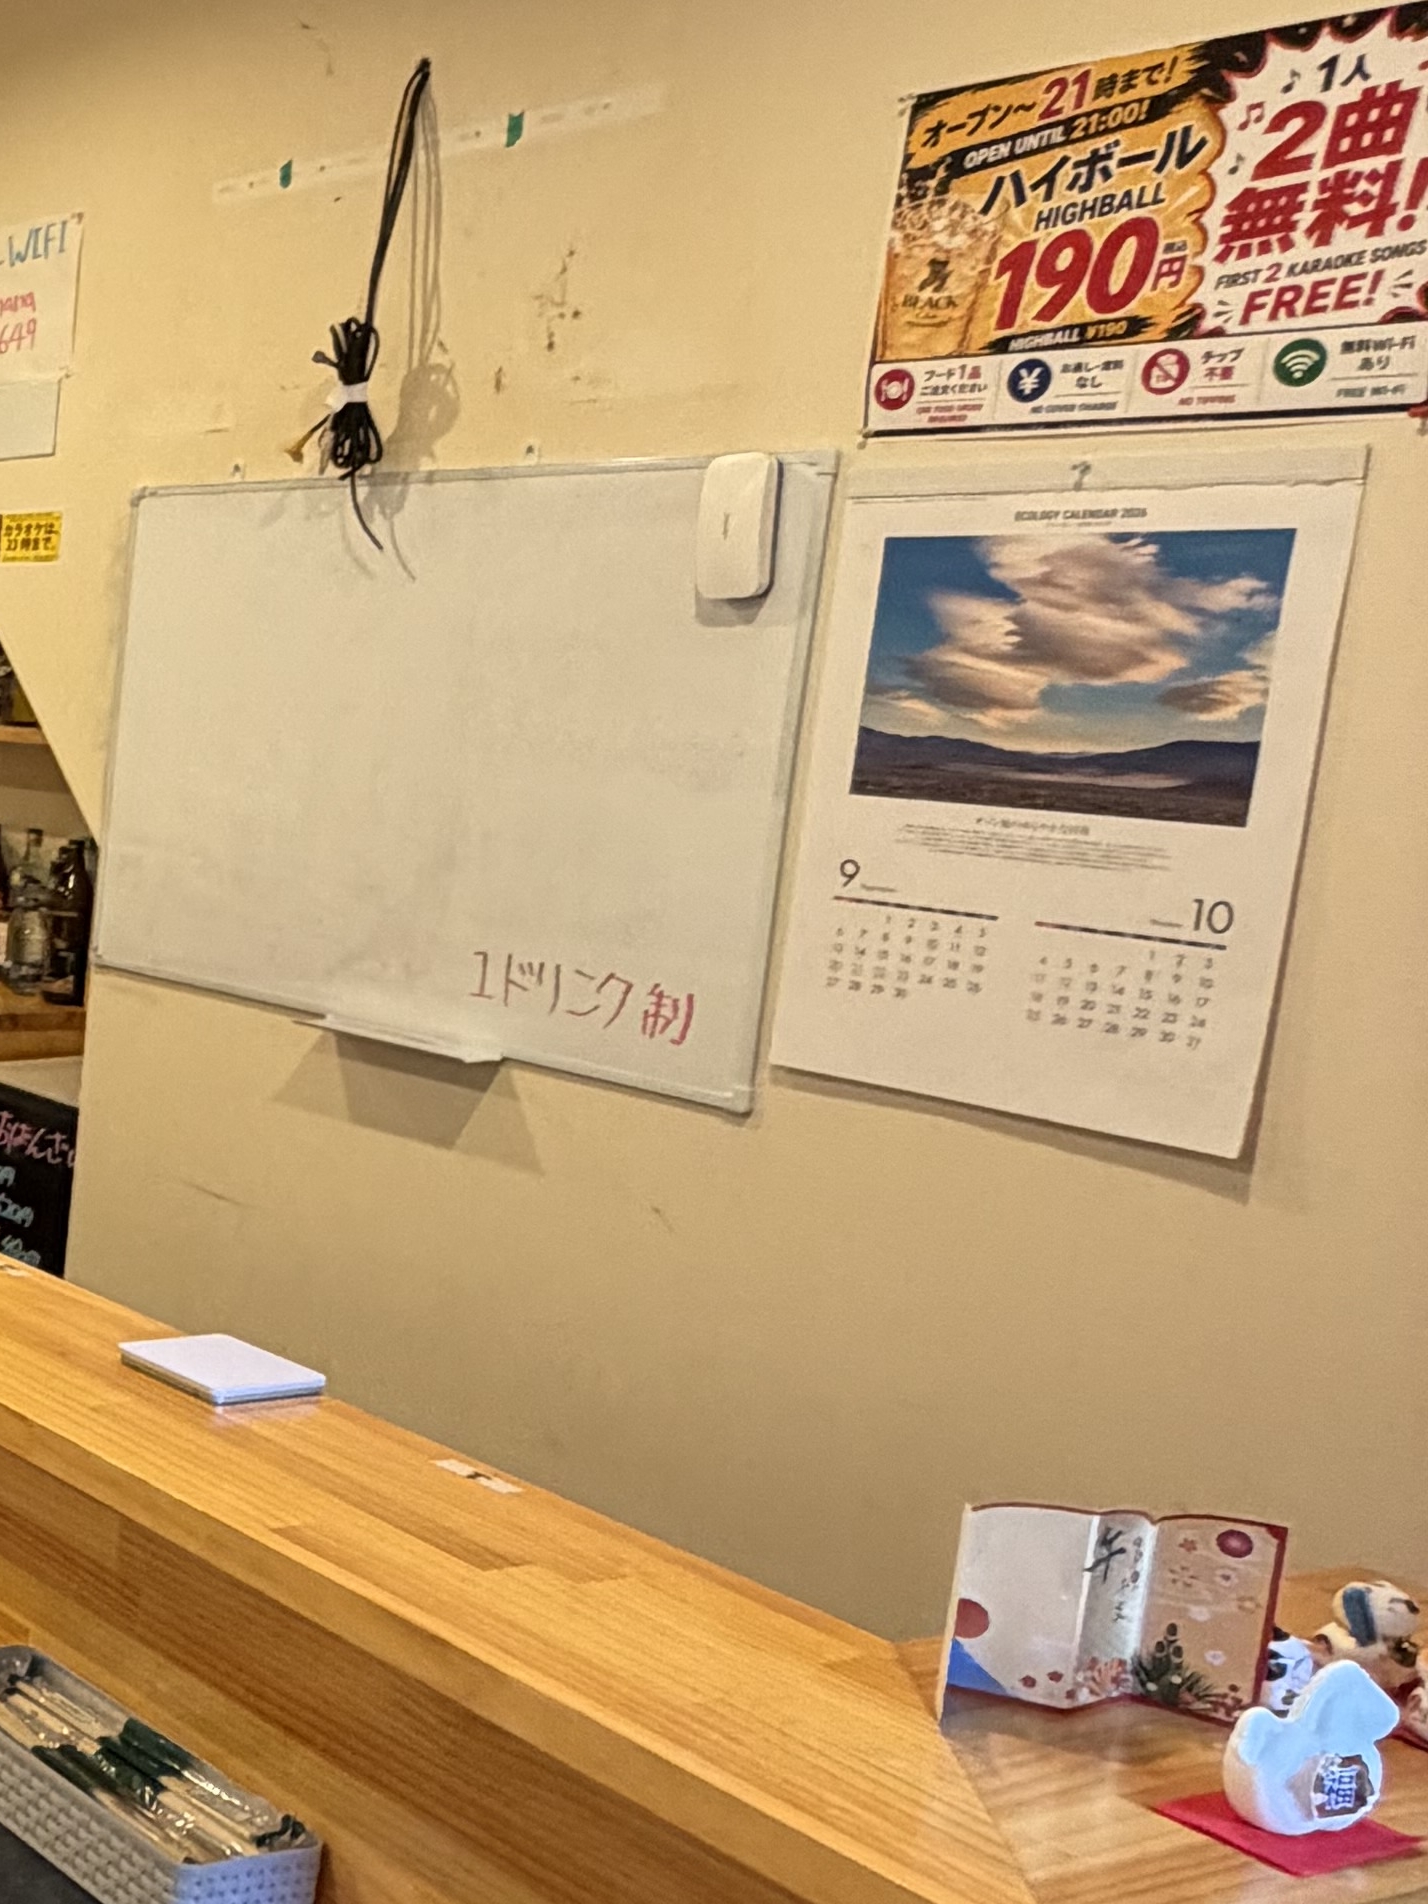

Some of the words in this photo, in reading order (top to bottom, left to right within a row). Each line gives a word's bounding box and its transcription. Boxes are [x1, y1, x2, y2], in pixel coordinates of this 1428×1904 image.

[1317, 53, 1371, 93] 1人
[964, 142, 1011, 169] OPEN
[1015, 126, 1066, 156] UNTIL
[1068, 99, 1152, 140] 21:00!
[1251, 79, 1423, 181] 2曲
[979, 123, 1210, 216] ハイボール
[1034, 182, 1166, 234] HIGHBALL
[1214, 268, 1263, 290] FIRST
[1263, 262, 1283, 284] 2
[1284, 249, 1367, 279] KARAOKE
[1369, 239, 1428, 264] SONGS
[902, 294, 958, 310] BLACK
[1238, 268, 1386, 326] FREE!
[1008, 328, 1081, 352] HIGHBALL
[1201, 347, 1245, 365] チップ
[1075, 376, 1103, 389] なし
[1357, 356, 1391, 371] あり
[840, 859, 861, 887] 9
[1193, 898, 1234, 934] 10
[469, 951, 695, 1046] 1ドリンク制
